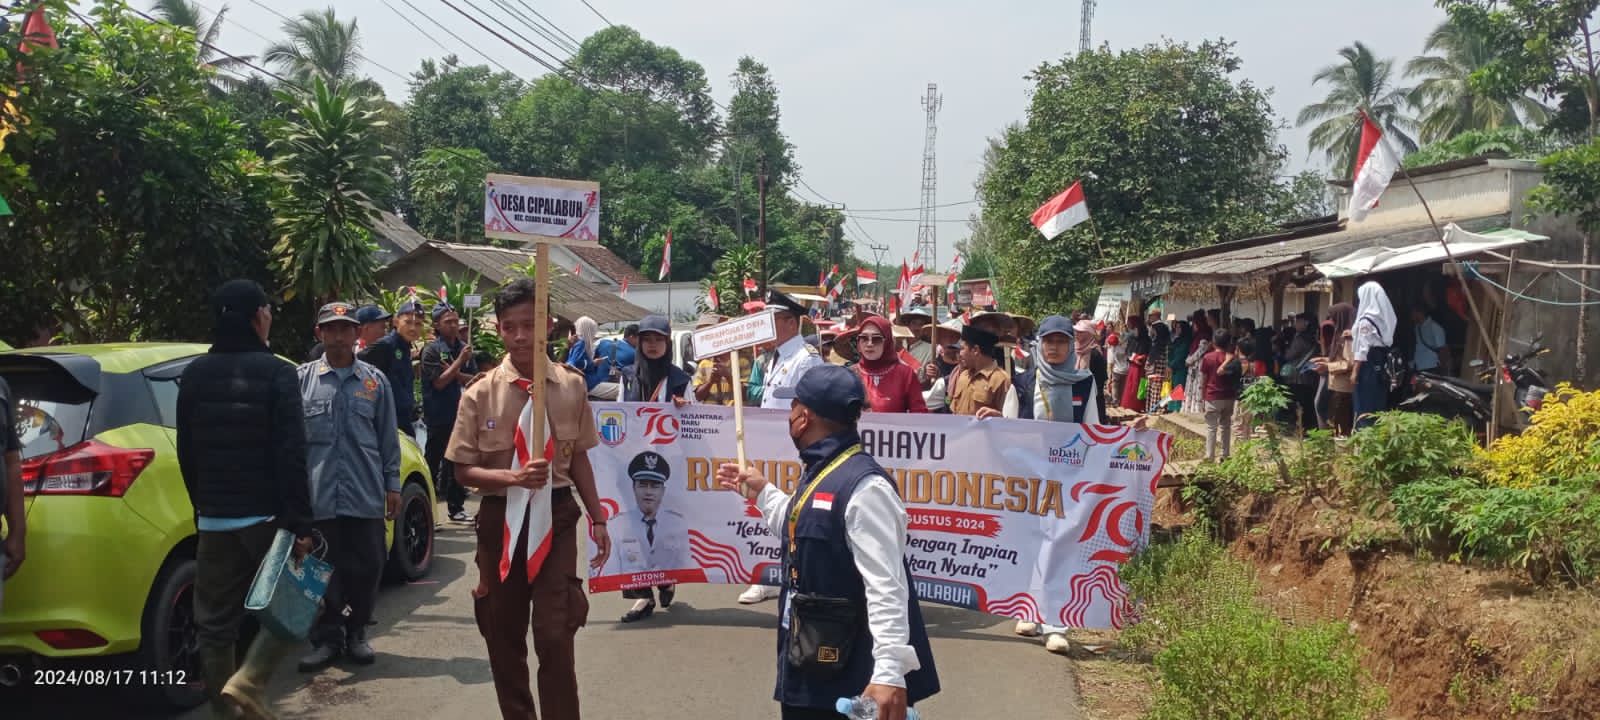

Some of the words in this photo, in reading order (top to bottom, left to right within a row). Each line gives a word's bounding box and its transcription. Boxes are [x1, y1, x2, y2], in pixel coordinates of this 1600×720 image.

[501, 194, 525, 213] DESA
[527, 196, 583, 218] CIPALABUH
[680, 413, 723, 421] NUSANTARA
[680, 419, 700, 427] BARU
[862, 429, 946, 461] AHAYU
[955, 517, 985, 530] 2024
[746, 541, 782, 560] Yang
[961, 538, 1018, 565] Impian
[632, 572, 665, 581] SUTONO
